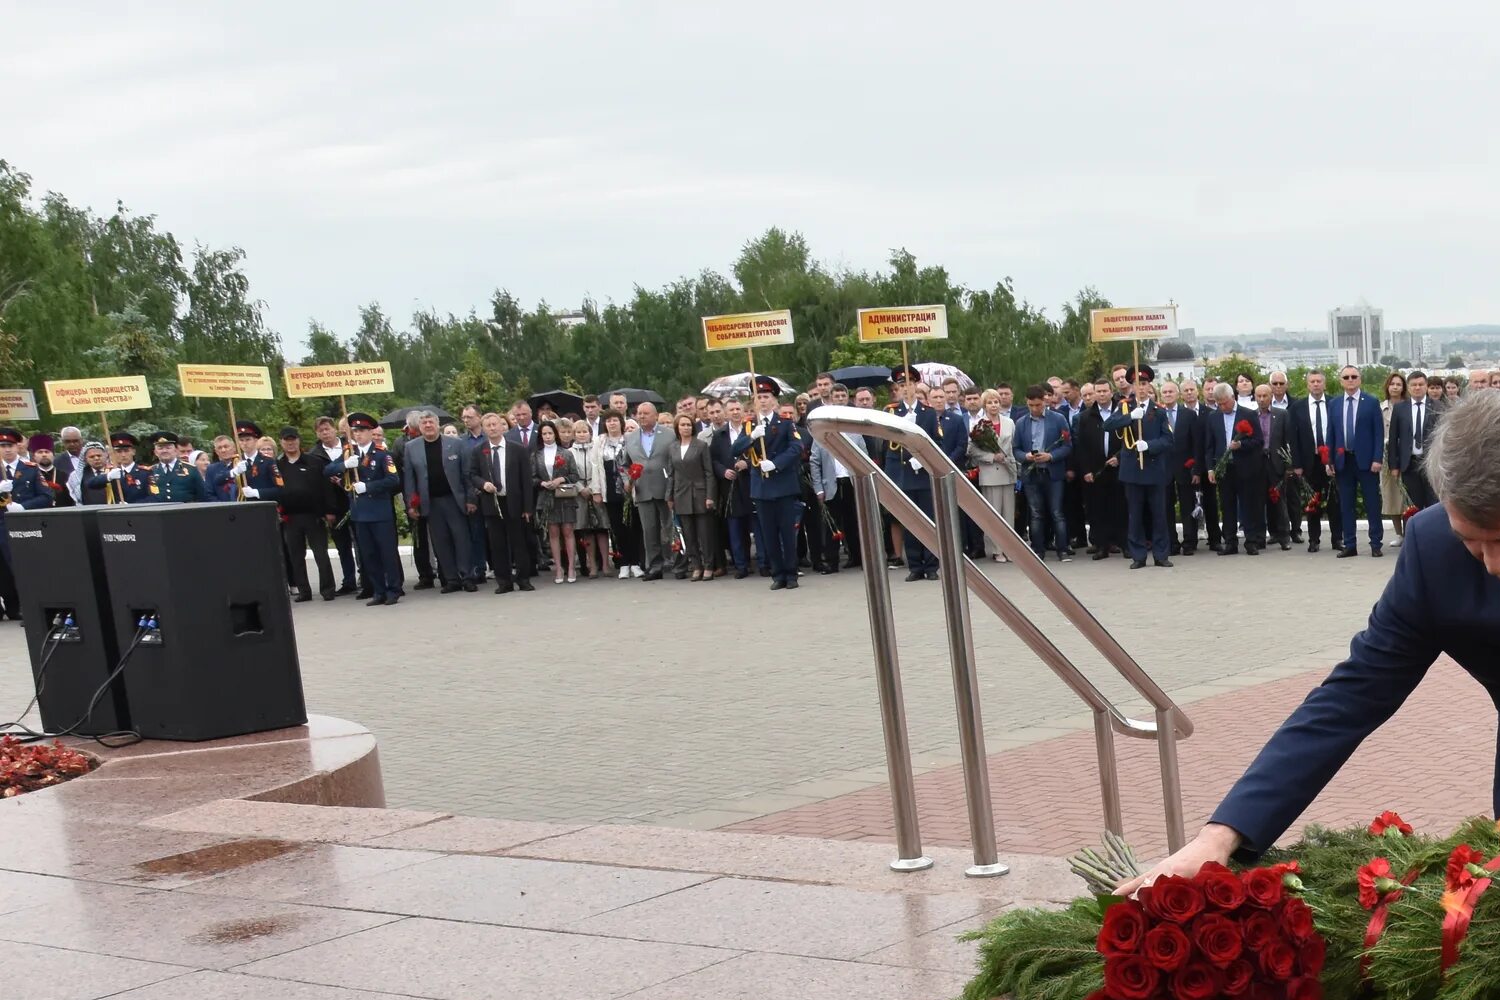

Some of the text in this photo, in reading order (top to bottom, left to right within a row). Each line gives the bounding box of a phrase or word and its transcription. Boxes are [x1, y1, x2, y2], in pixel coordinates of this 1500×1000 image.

[868, 312, 936, 324] АДМИНИСТРАЦИЯ
[707, 319, 787, 332] ЧЕБОКСАРСКОЕ ГОРОДСКОЕ
[877, 325, 931, 335] г. Чебоксары
[1135, 324, 1168, 332] РЕСПУБЛИКИ
[716, 328, 781, 340] СОБРАНИЕ ДЕПУТАТОВ
[290, 366, 385, 380] ветераны боевых действий
[302, 380, 342, 390] Республике
[344, 378, 385, 387] Афганистан
[55, 384, 140, 397] офицеры товарищества
[93, 394, 132, 404] отечества»
